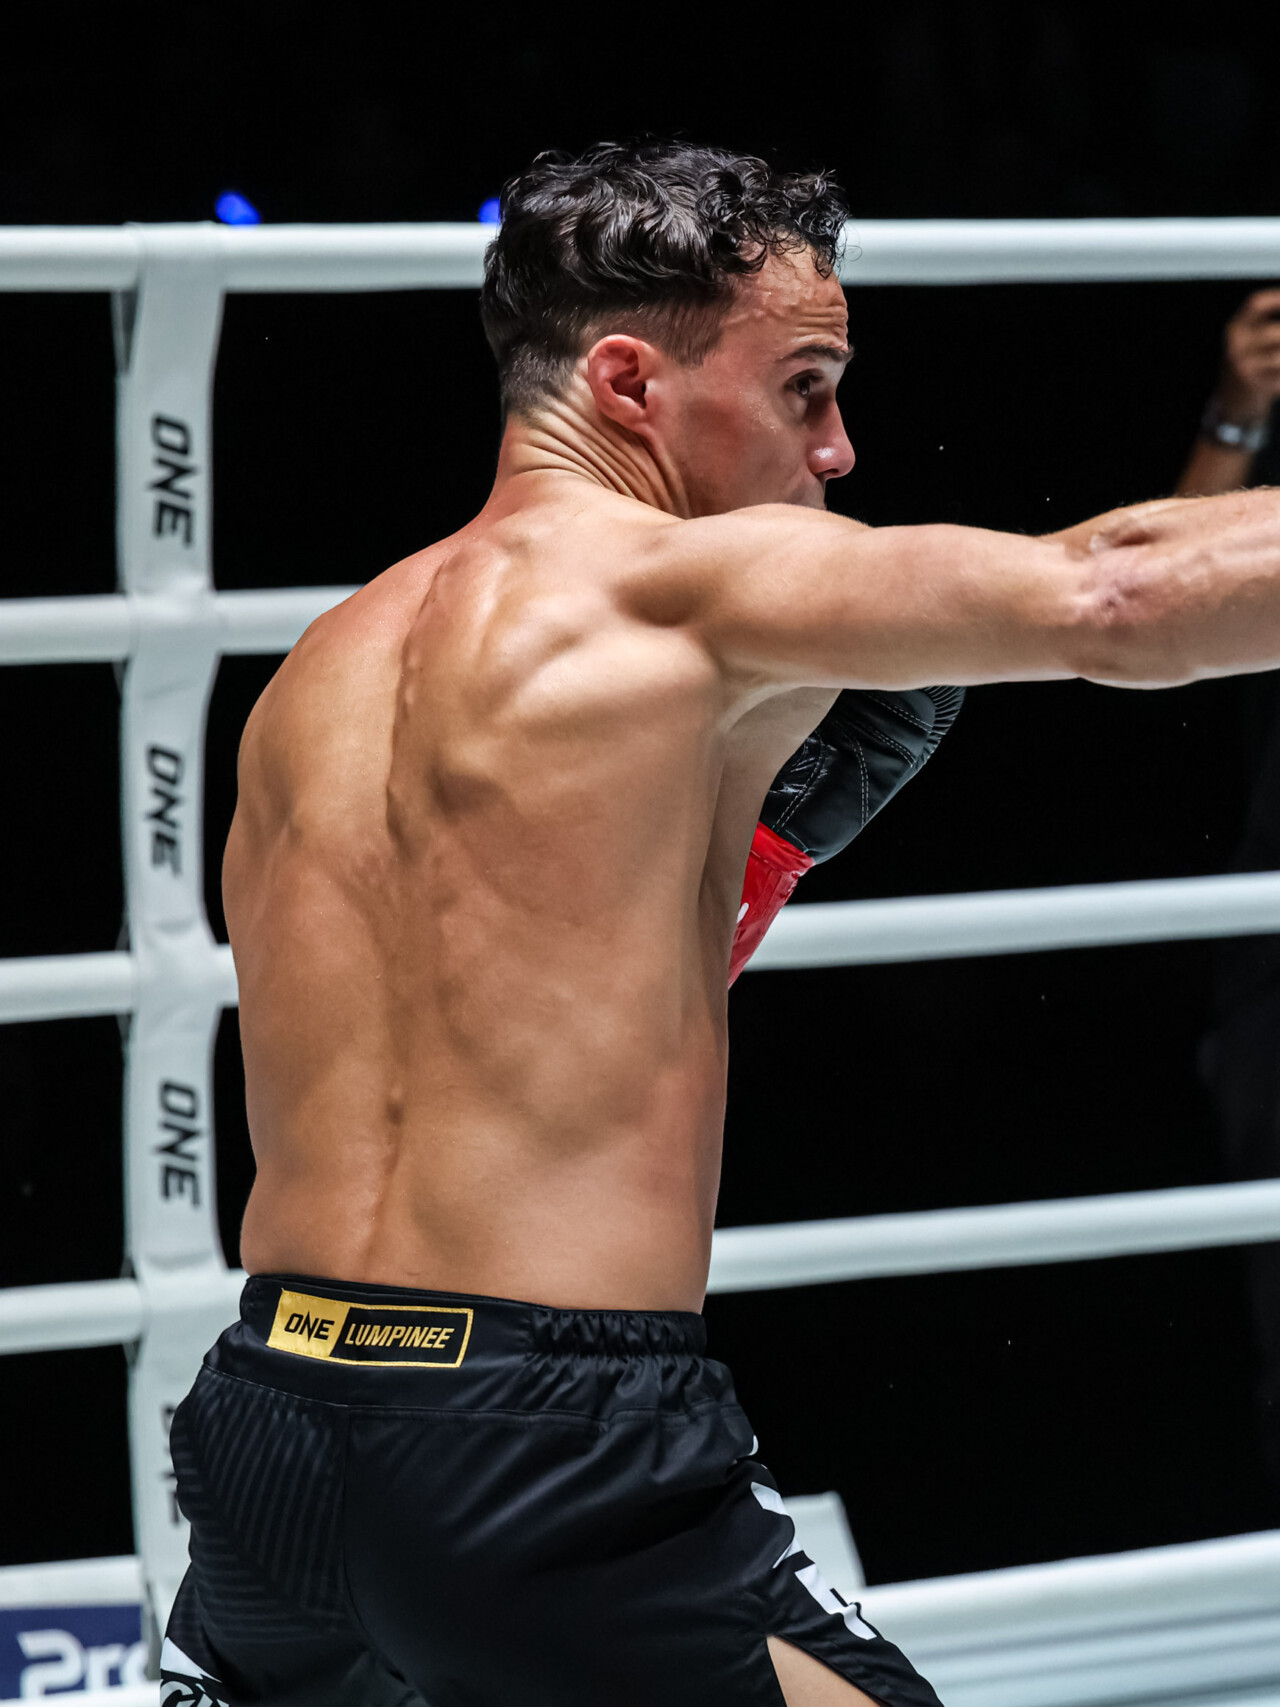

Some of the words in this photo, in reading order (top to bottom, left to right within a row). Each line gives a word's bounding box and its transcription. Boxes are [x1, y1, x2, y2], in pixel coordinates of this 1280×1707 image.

[148, 412, 199, 549] ONE
[144, 743, 186, 878] ONE
[153, 1079, 203, 1208] ONE
[284, 1311, 335, 1342] ONE
[344, 1323, 455, 1349] LUMPINEE
